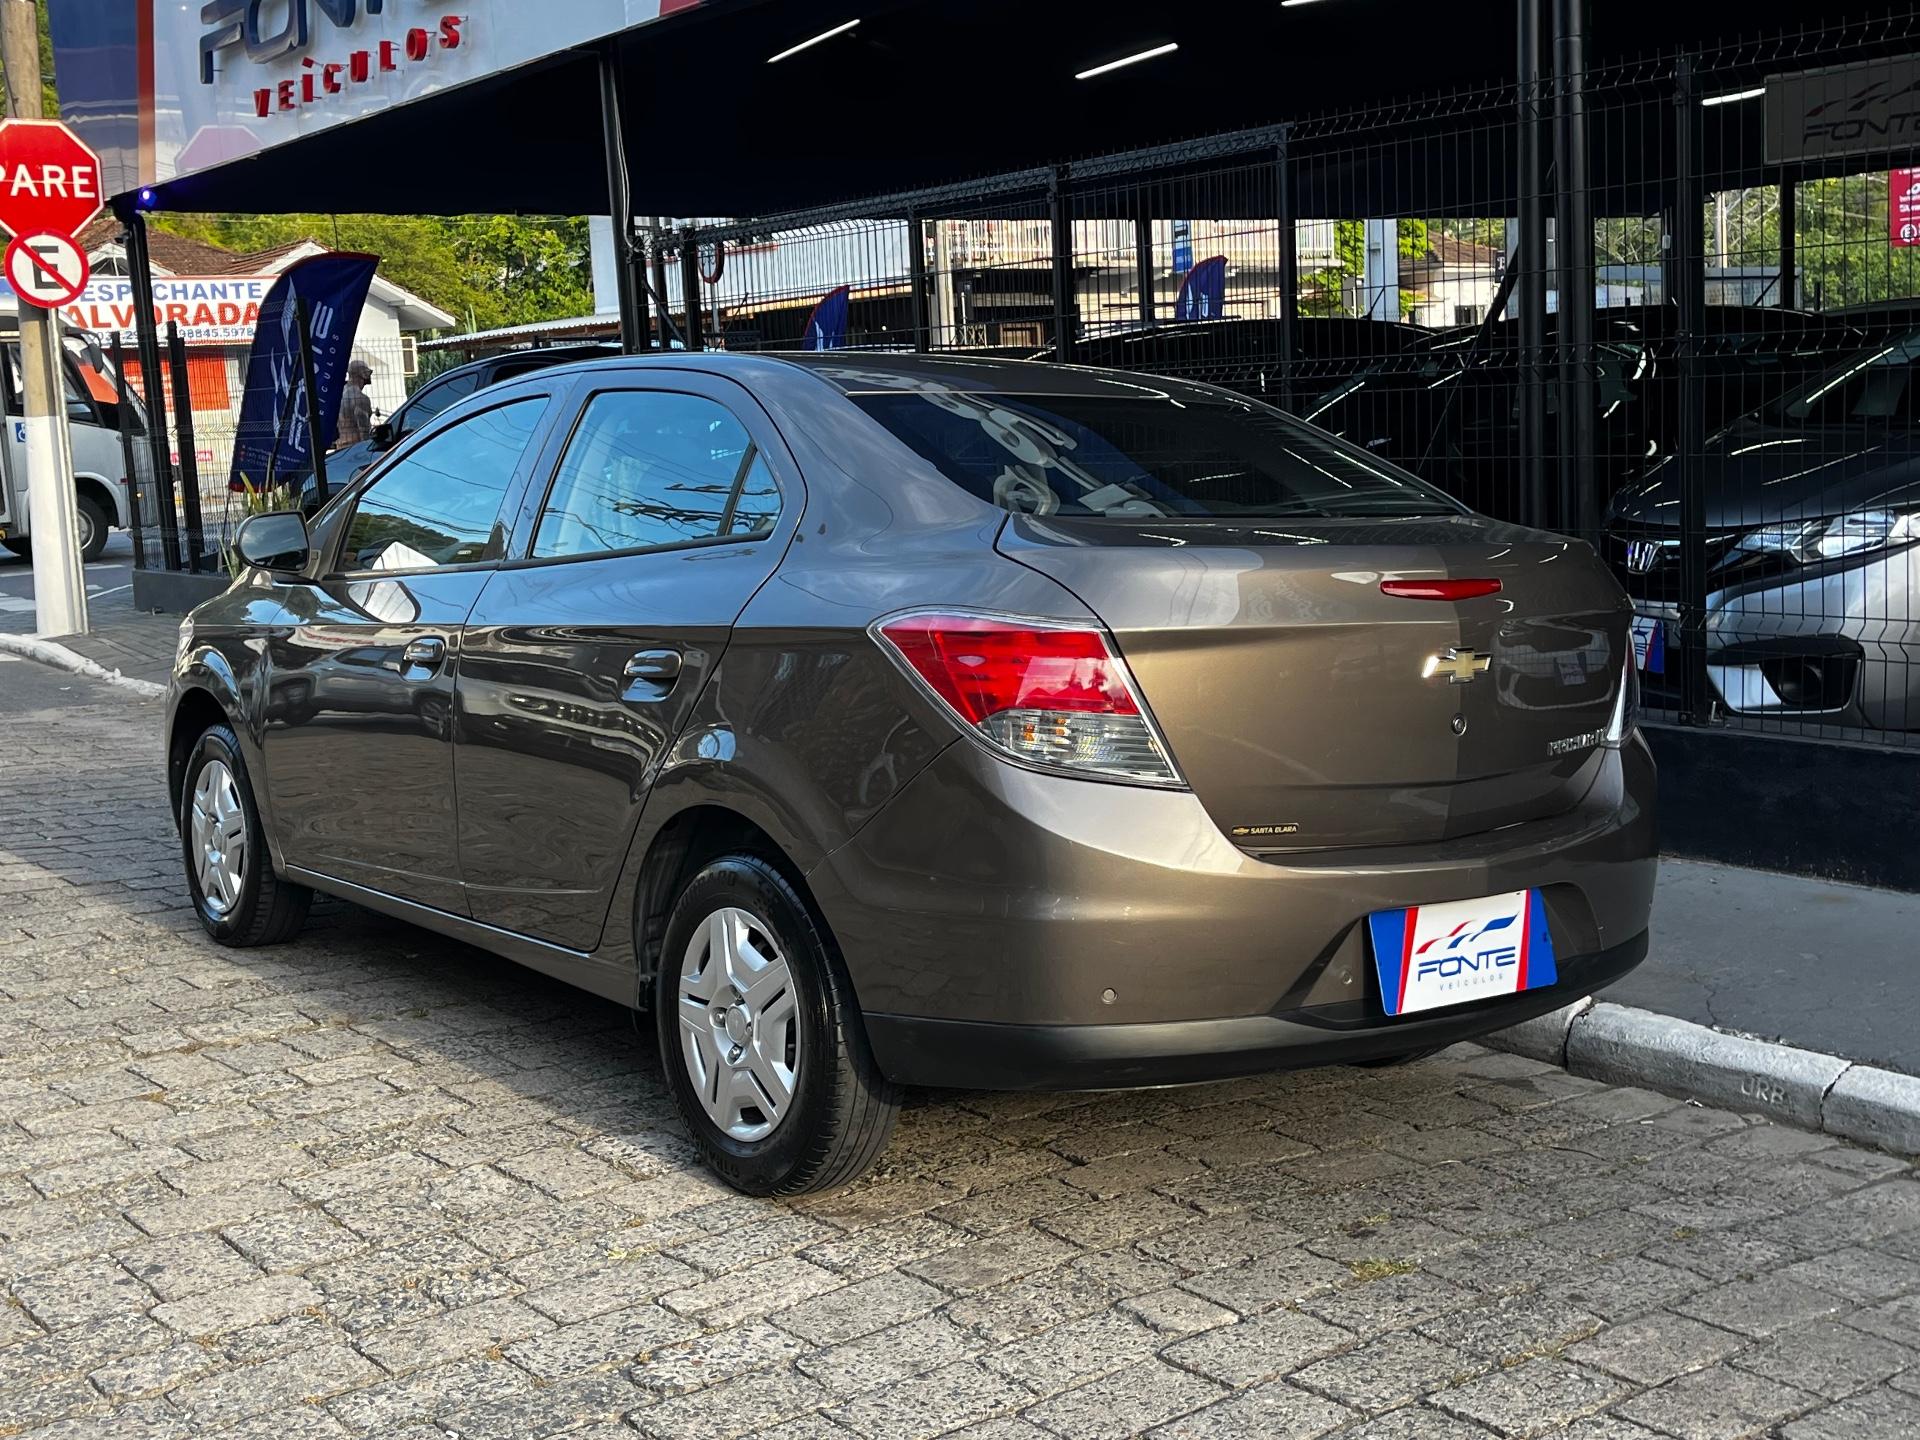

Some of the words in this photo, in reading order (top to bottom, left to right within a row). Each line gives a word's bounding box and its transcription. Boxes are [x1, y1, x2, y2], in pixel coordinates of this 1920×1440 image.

[0, 164, 96, 199] ARE
[80, 282, 262, 303] ESPCHANTE
[1251, 826, 1273, 835] SANTA
[1418, 945, 1516, 982] FONTE
